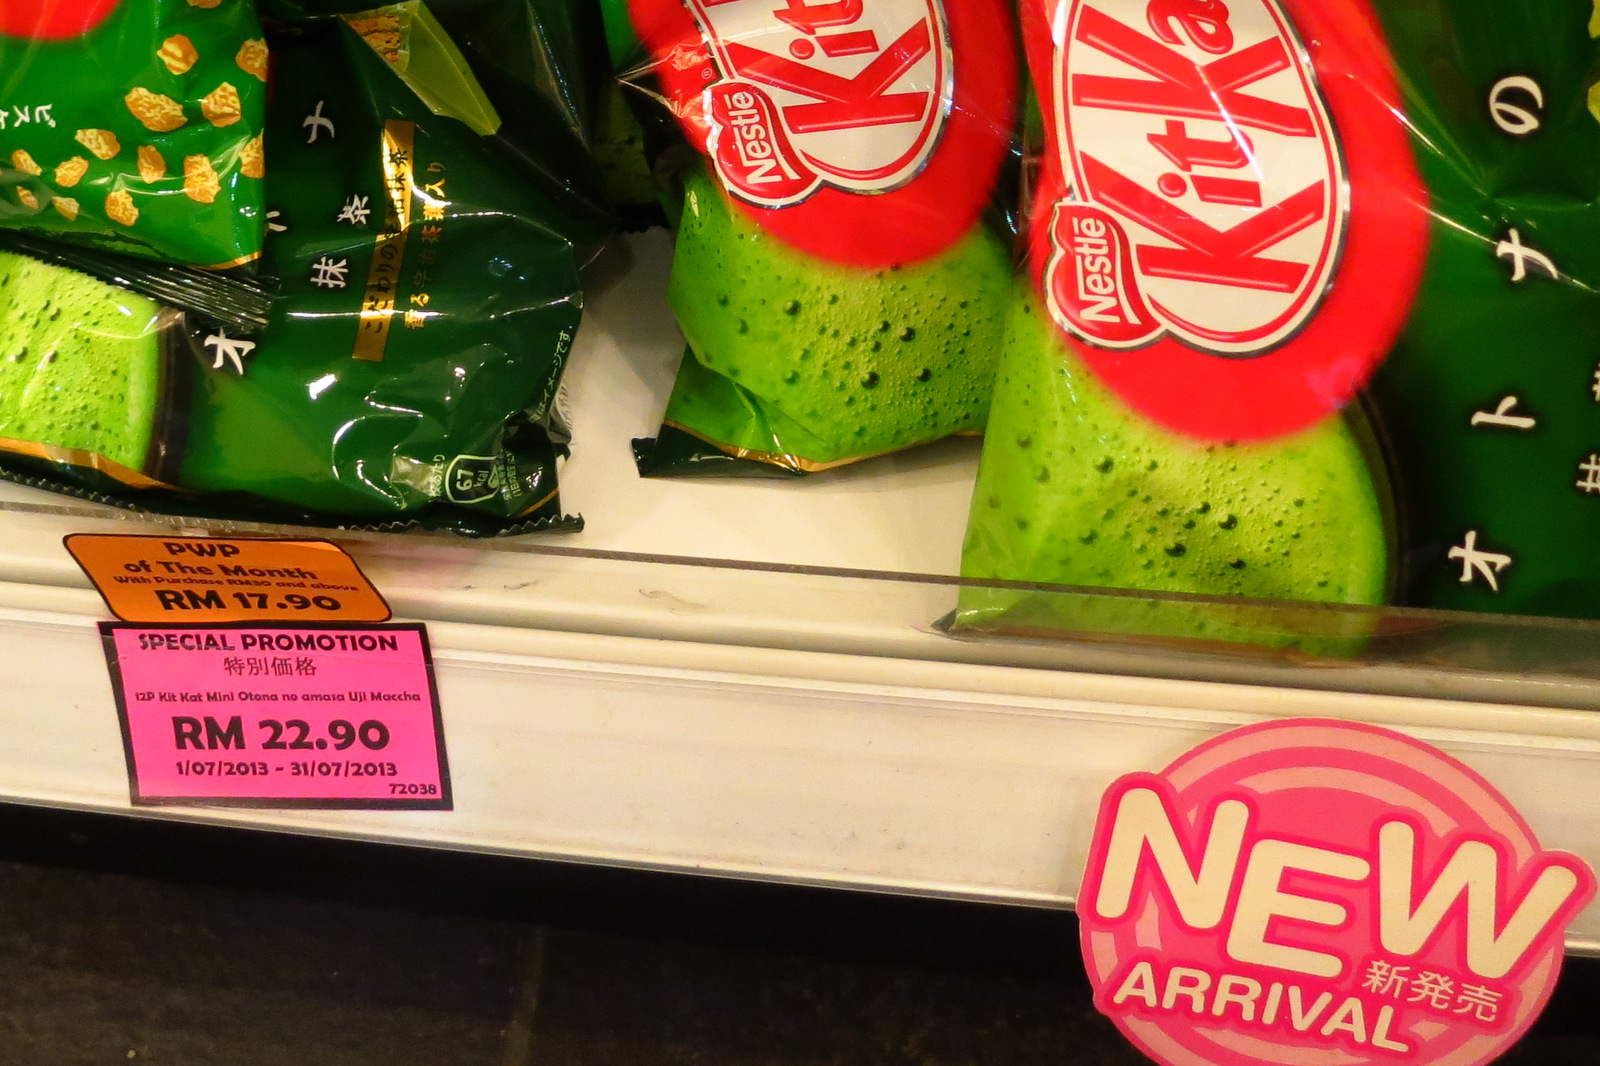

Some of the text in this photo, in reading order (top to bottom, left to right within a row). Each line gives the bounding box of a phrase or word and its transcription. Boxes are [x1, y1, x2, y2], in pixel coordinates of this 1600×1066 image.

[455, 469, 475, 491] 67
[164, 542, 240, 558] PWP
[124, 560, 319, 580] of The Month
[113, 575, 152, 585] With
[154, 576, 223, 587] Purchase
[276, 581, 306, 589] and
[310, 583, 360, 592] above
[154, 589, 342, 612] RM 17.90
[138, 633, 399, 651] SPECIAL PROMOTION
[223, 656, 318, 677] 特別価格
[158, 691, 178, 702] Kit
[180, 692, 204, 703] Kat
[206, 691, 235, 702] Mini
[238, 691, 279, 702] Otona
[281, 694, 299, 702] no
[301, 693, 346, 702] amasa
[348, 691, 367, 703] Uji
[370, 691, 421, 702] Maccha
[171, 715, 391, 751] RM 22.90
[175, 759, 270, 777] 1/07/2013
[290, 759, 399, 778] 31/07/2013
[388, 783, 438, 796] 72038
[1095, 787, 1578, 981] NEW
[1361, 959, 1504, 1022] 新発売
[1112, 961, 1410, 1053] ARRIVAL
